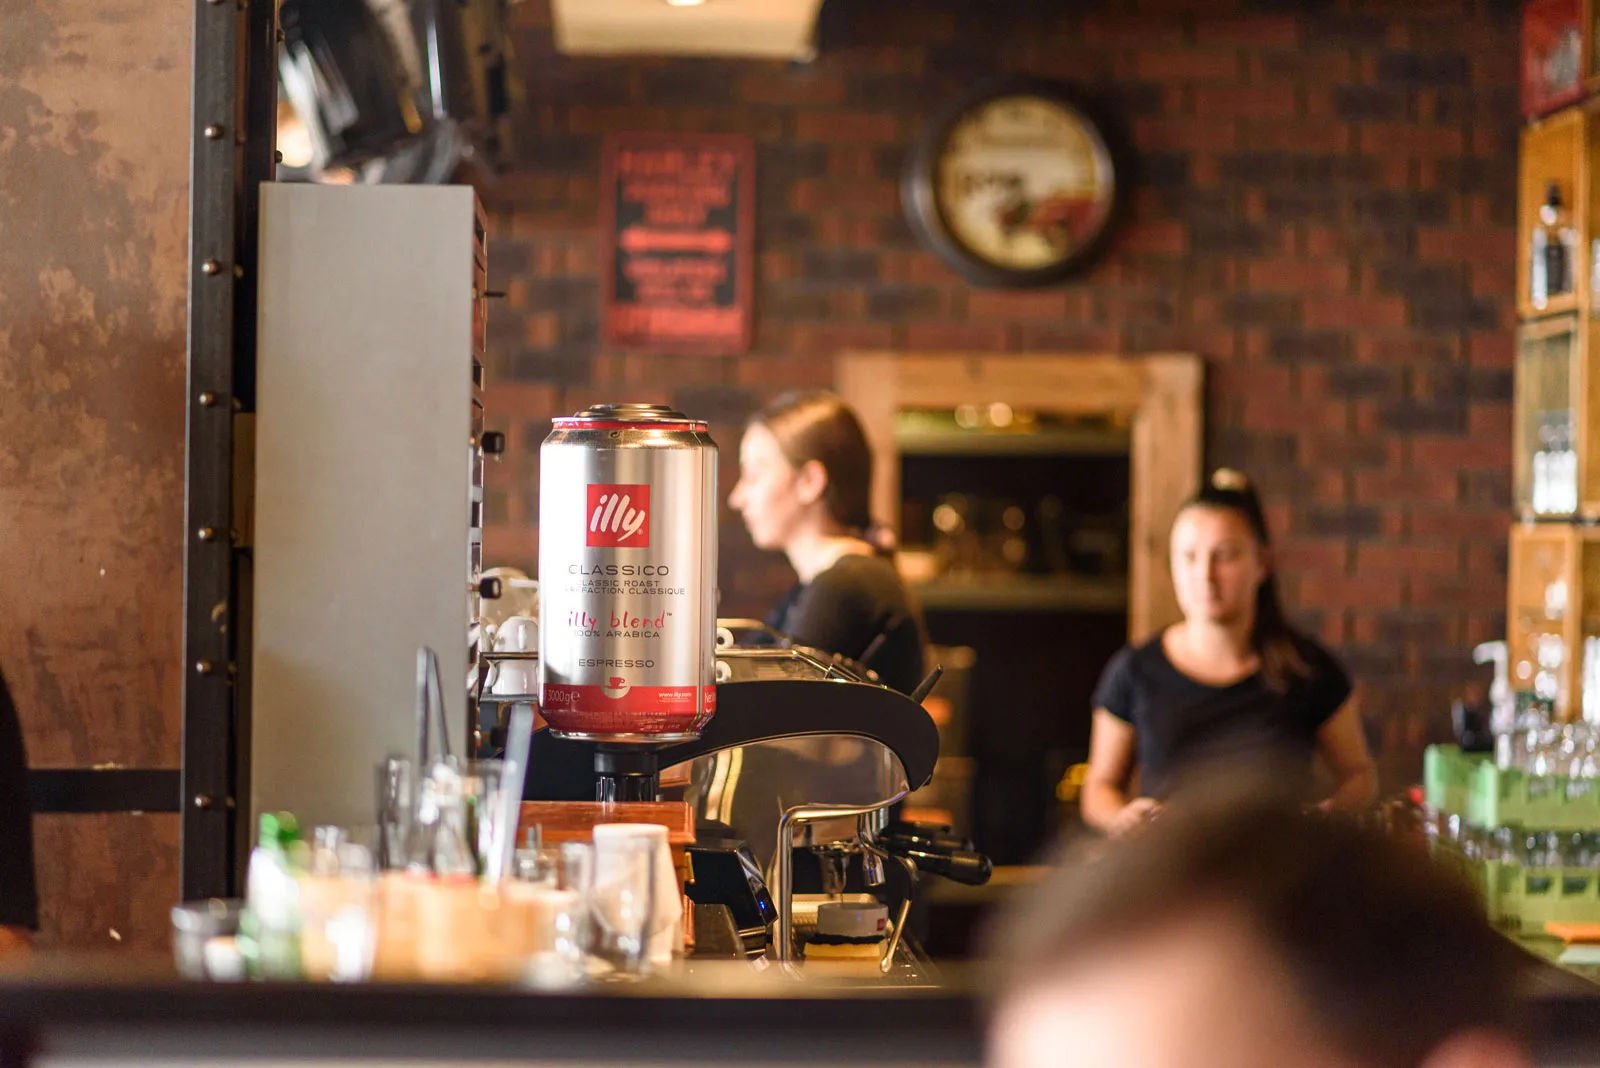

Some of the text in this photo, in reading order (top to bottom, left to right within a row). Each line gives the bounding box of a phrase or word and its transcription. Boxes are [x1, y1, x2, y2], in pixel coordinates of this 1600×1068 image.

[590, 493, 646, 542] illy
[568, 564, 670, 576] CLASSICO
[577, 579, 661, 588] LASSIC ROAST
[628, 587, 686, 595] CLASSIQUE
[568, 610, 597, 632] illy
[574, 629, 661, 639] 00% ARABICA
[578, 658, 655, 668] ESPRESSO
